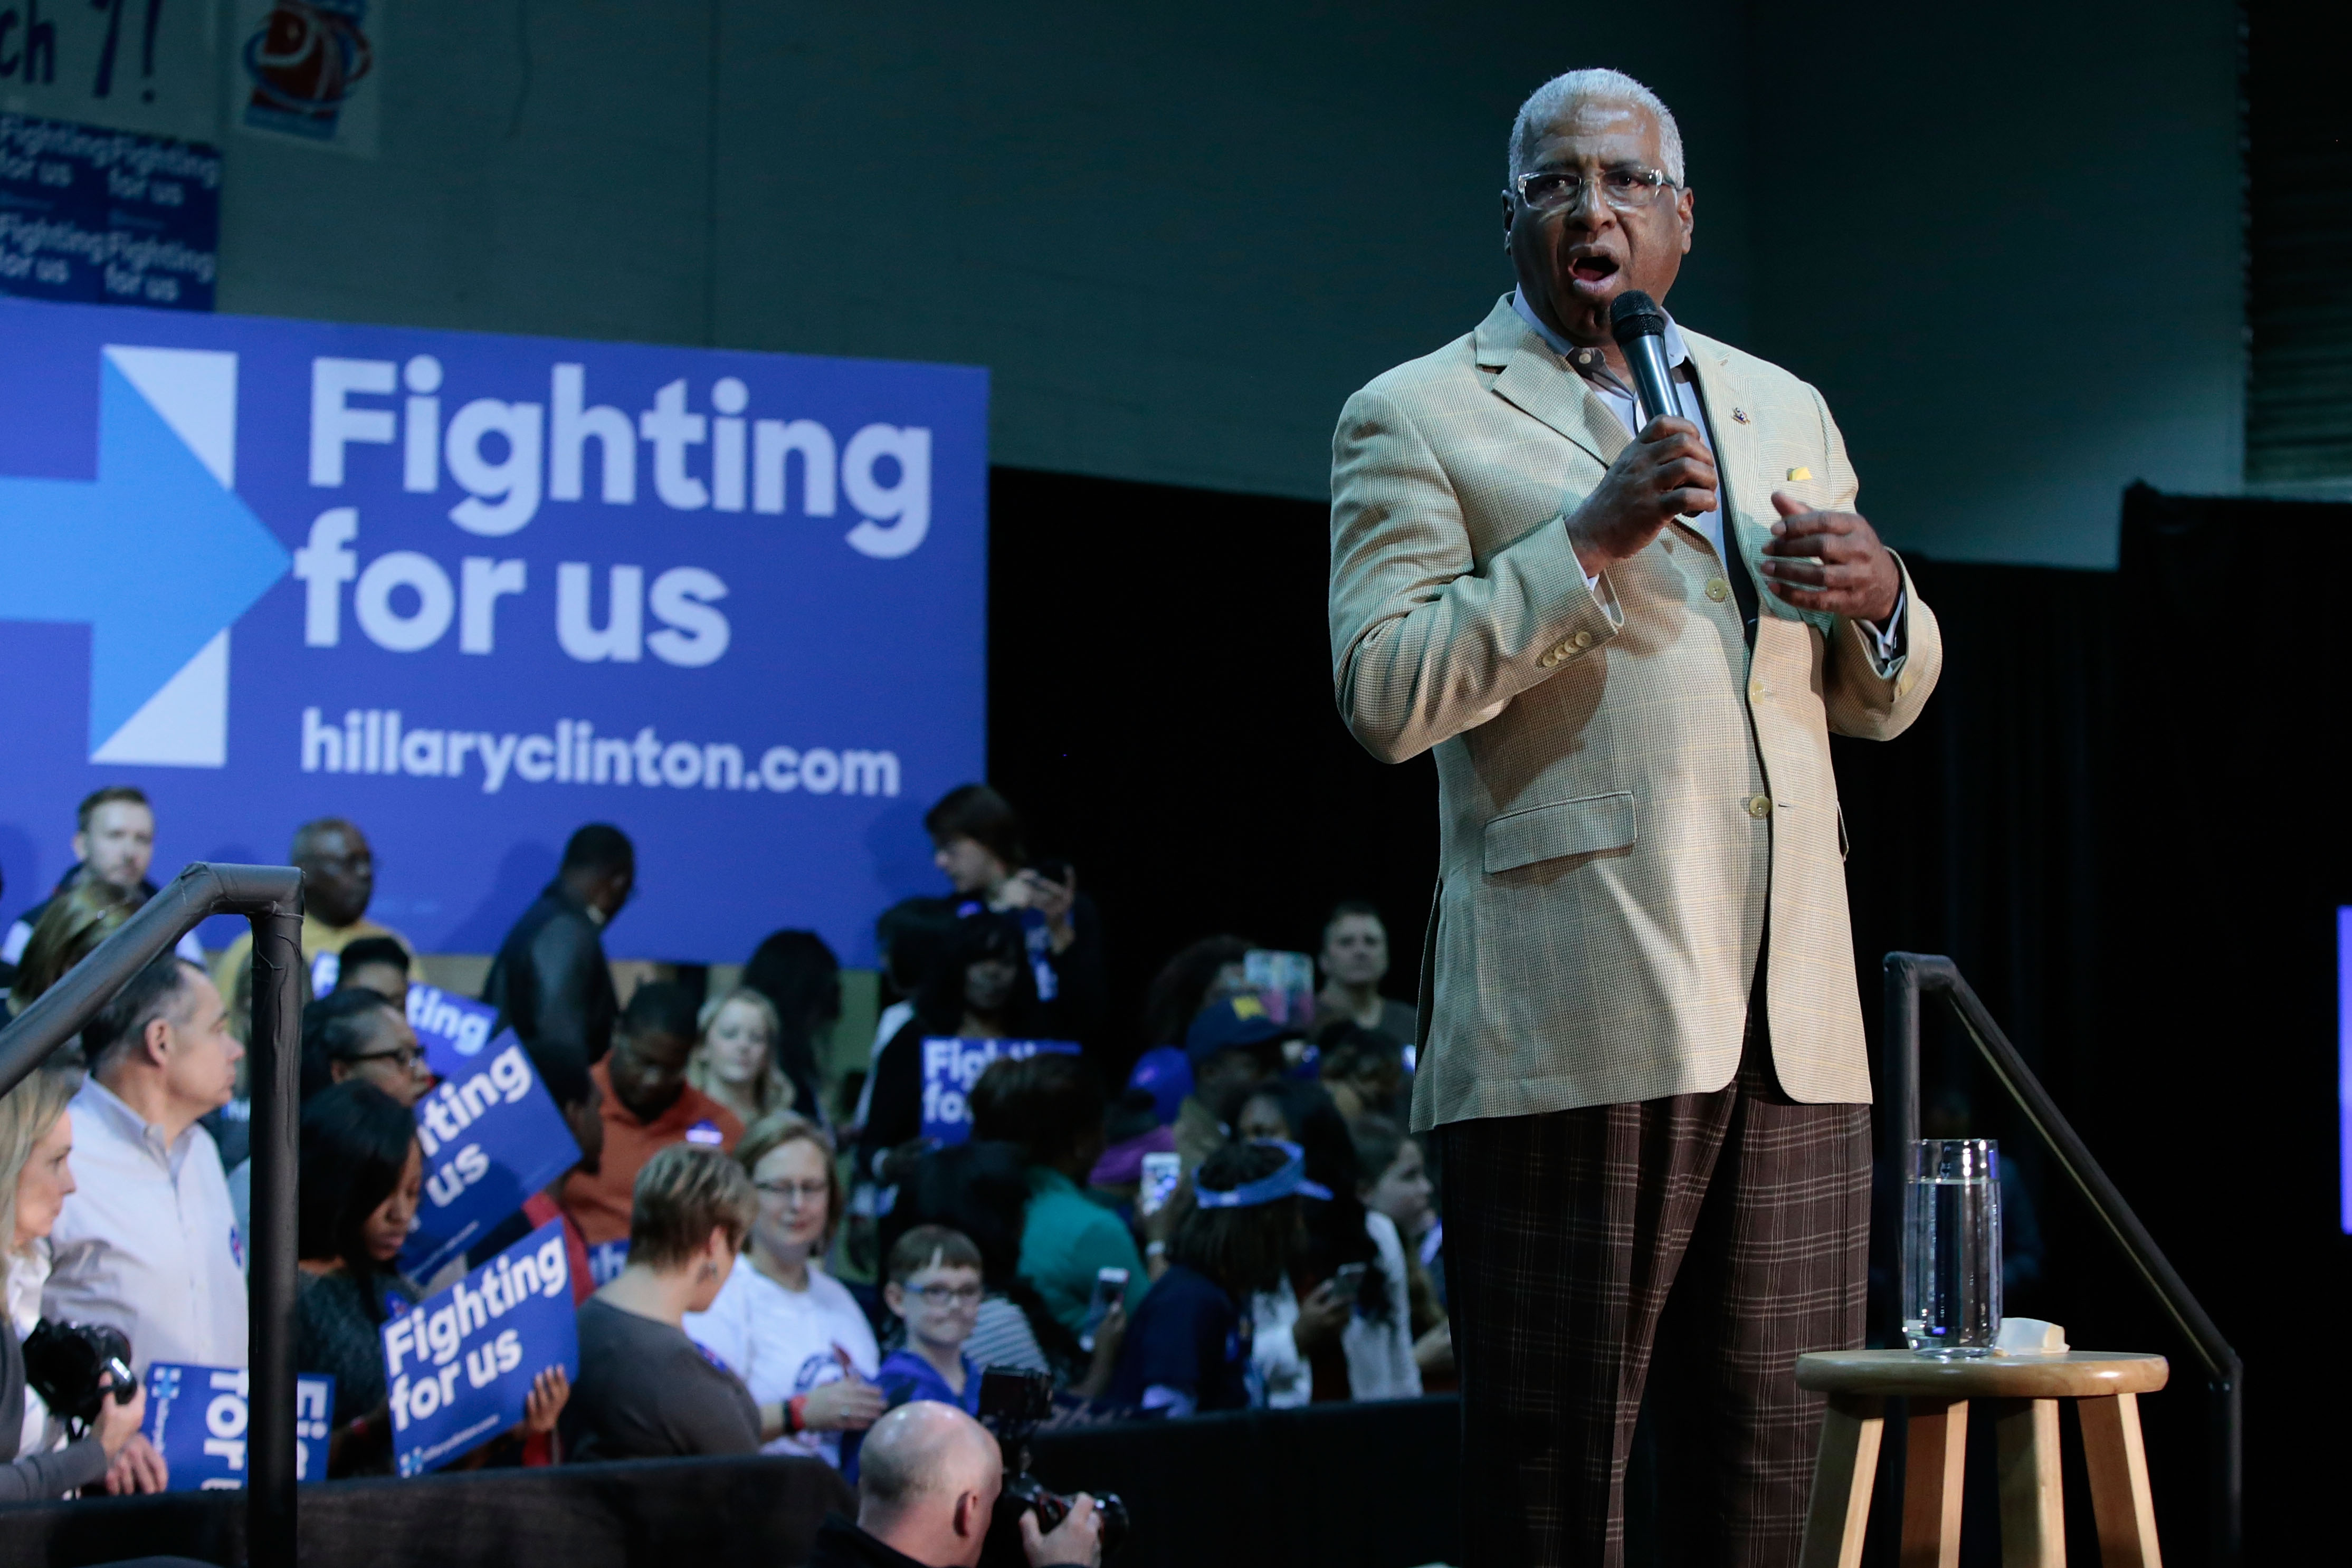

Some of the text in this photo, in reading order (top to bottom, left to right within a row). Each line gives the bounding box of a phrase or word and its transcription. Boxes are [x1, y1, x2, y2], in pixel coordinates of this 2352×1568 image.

[309, 355, 932, 560] Fighting
[293, 506, 731, 667] for us
[301, 706, 900, 797] hillaryclinton.com
[404, 983, 492, 1055] ting
[416, 1044, 533, 1158] ting
[424, 1143, 490, 1208] us
[384, 1235, 567, 1378] Fighting
[389, 1360, 461, 1431] for
[466, 1328, 523, 1389] us
